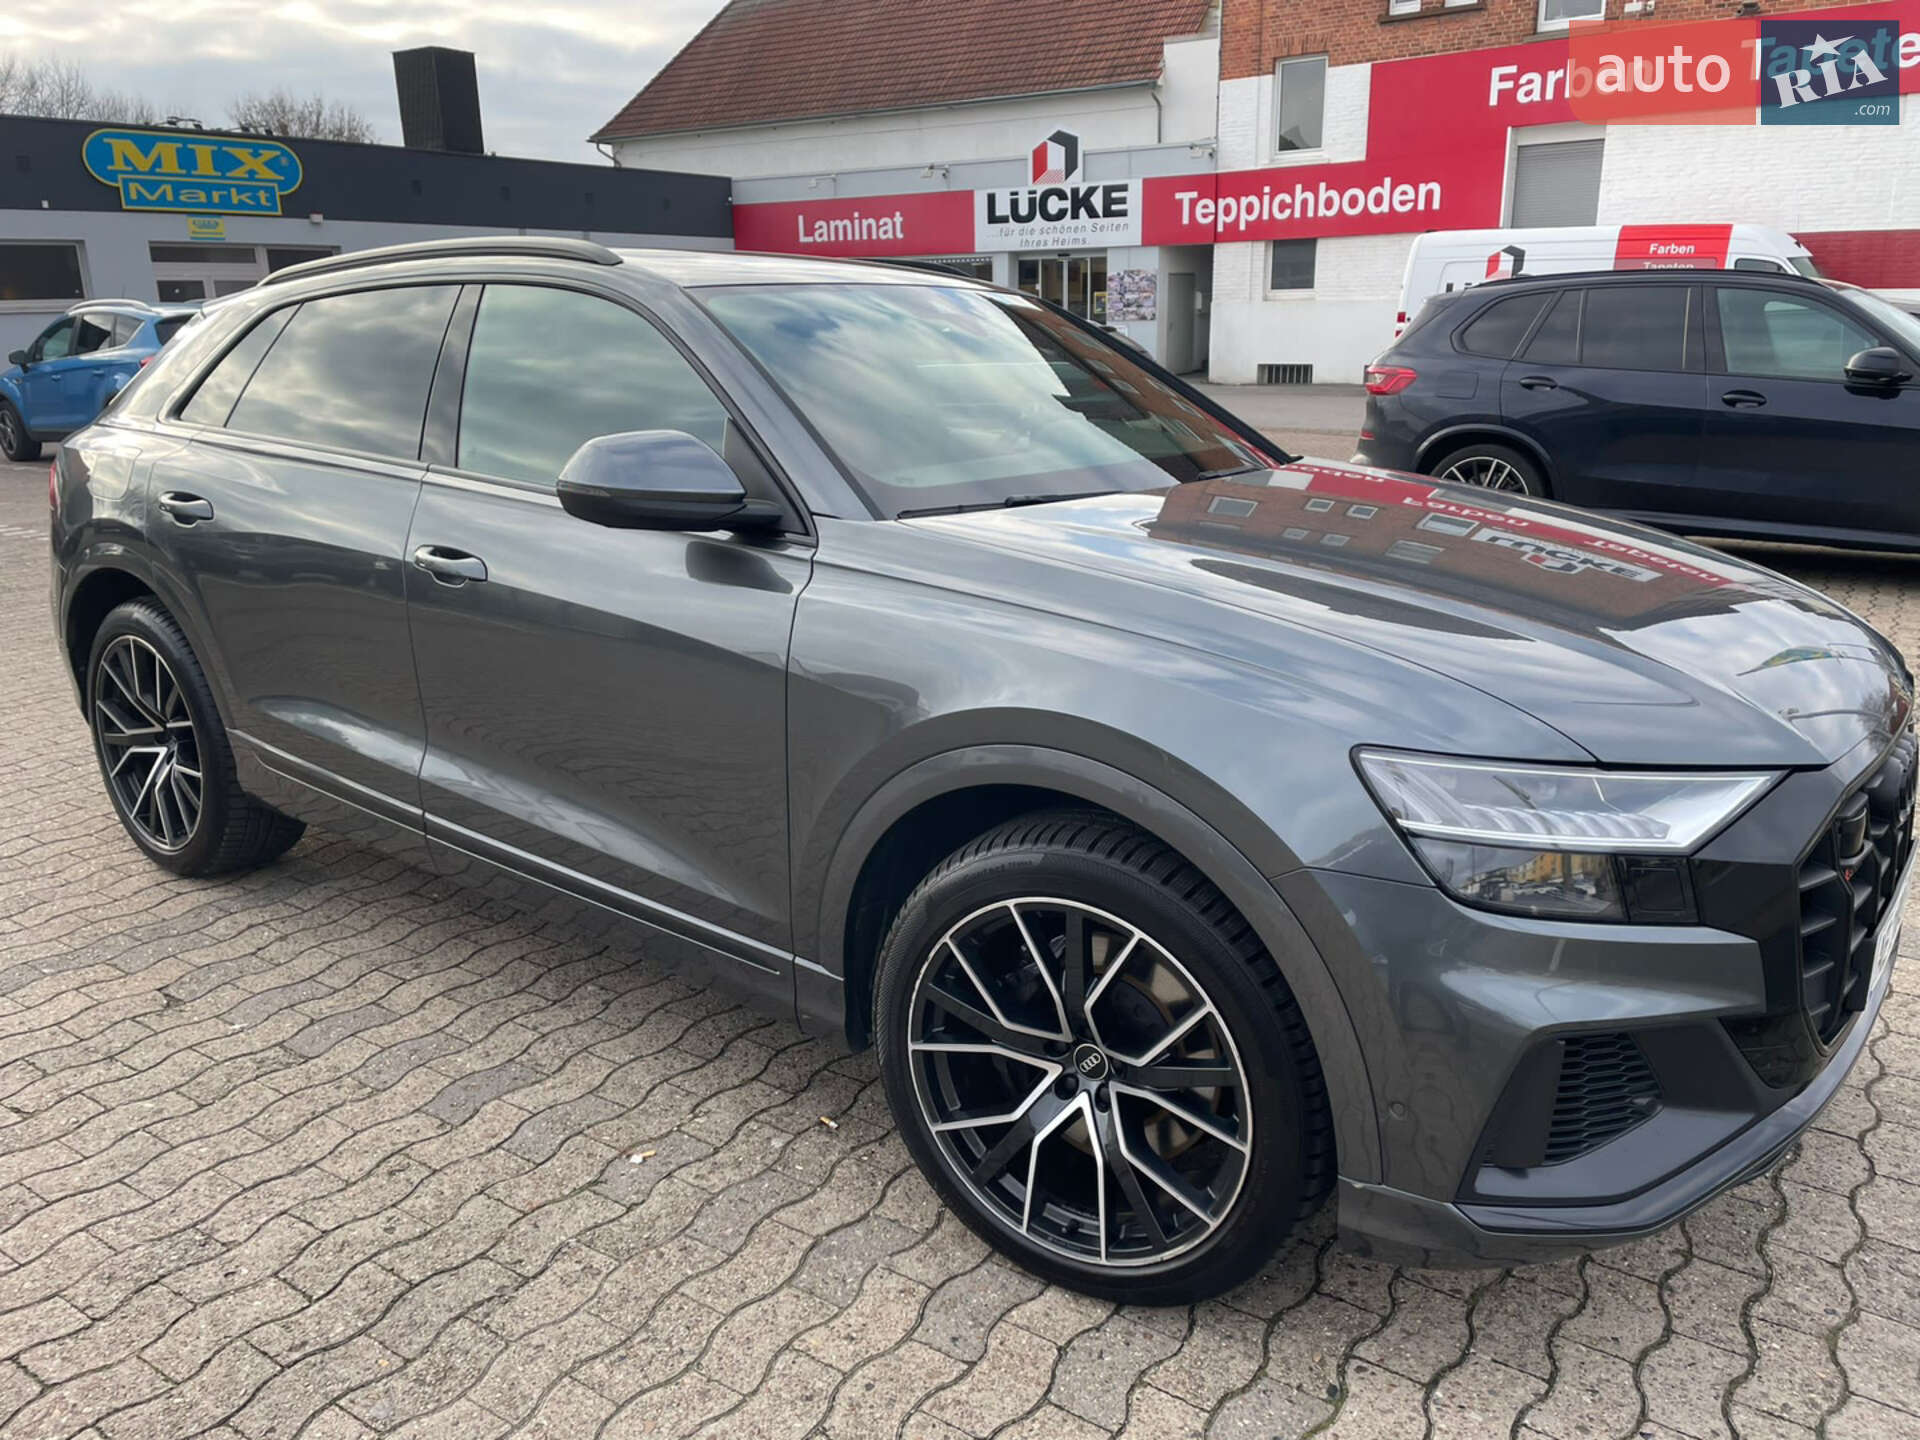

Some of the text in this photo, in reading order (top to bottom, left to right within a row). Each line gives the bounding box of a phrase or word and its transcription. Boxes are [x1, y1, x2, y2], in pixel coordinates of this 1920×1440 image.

[103, 138, 286, 181] MIX
[128, 182, 272, 207] Markt
[986, 183, 1129, 225] LÜCKE
[1174, 176, 1442, 233] Teppichboden
[797, 210, 904, 243] Laminat
[1018, 226, 1036, 237] die
[1039, 224, 1088, 235] schönen
[1090, 221, 1130, 233] Seiten
[1019, 237, 1049, 248] Ihres
[1648, 241, 1696, 255] Farben
